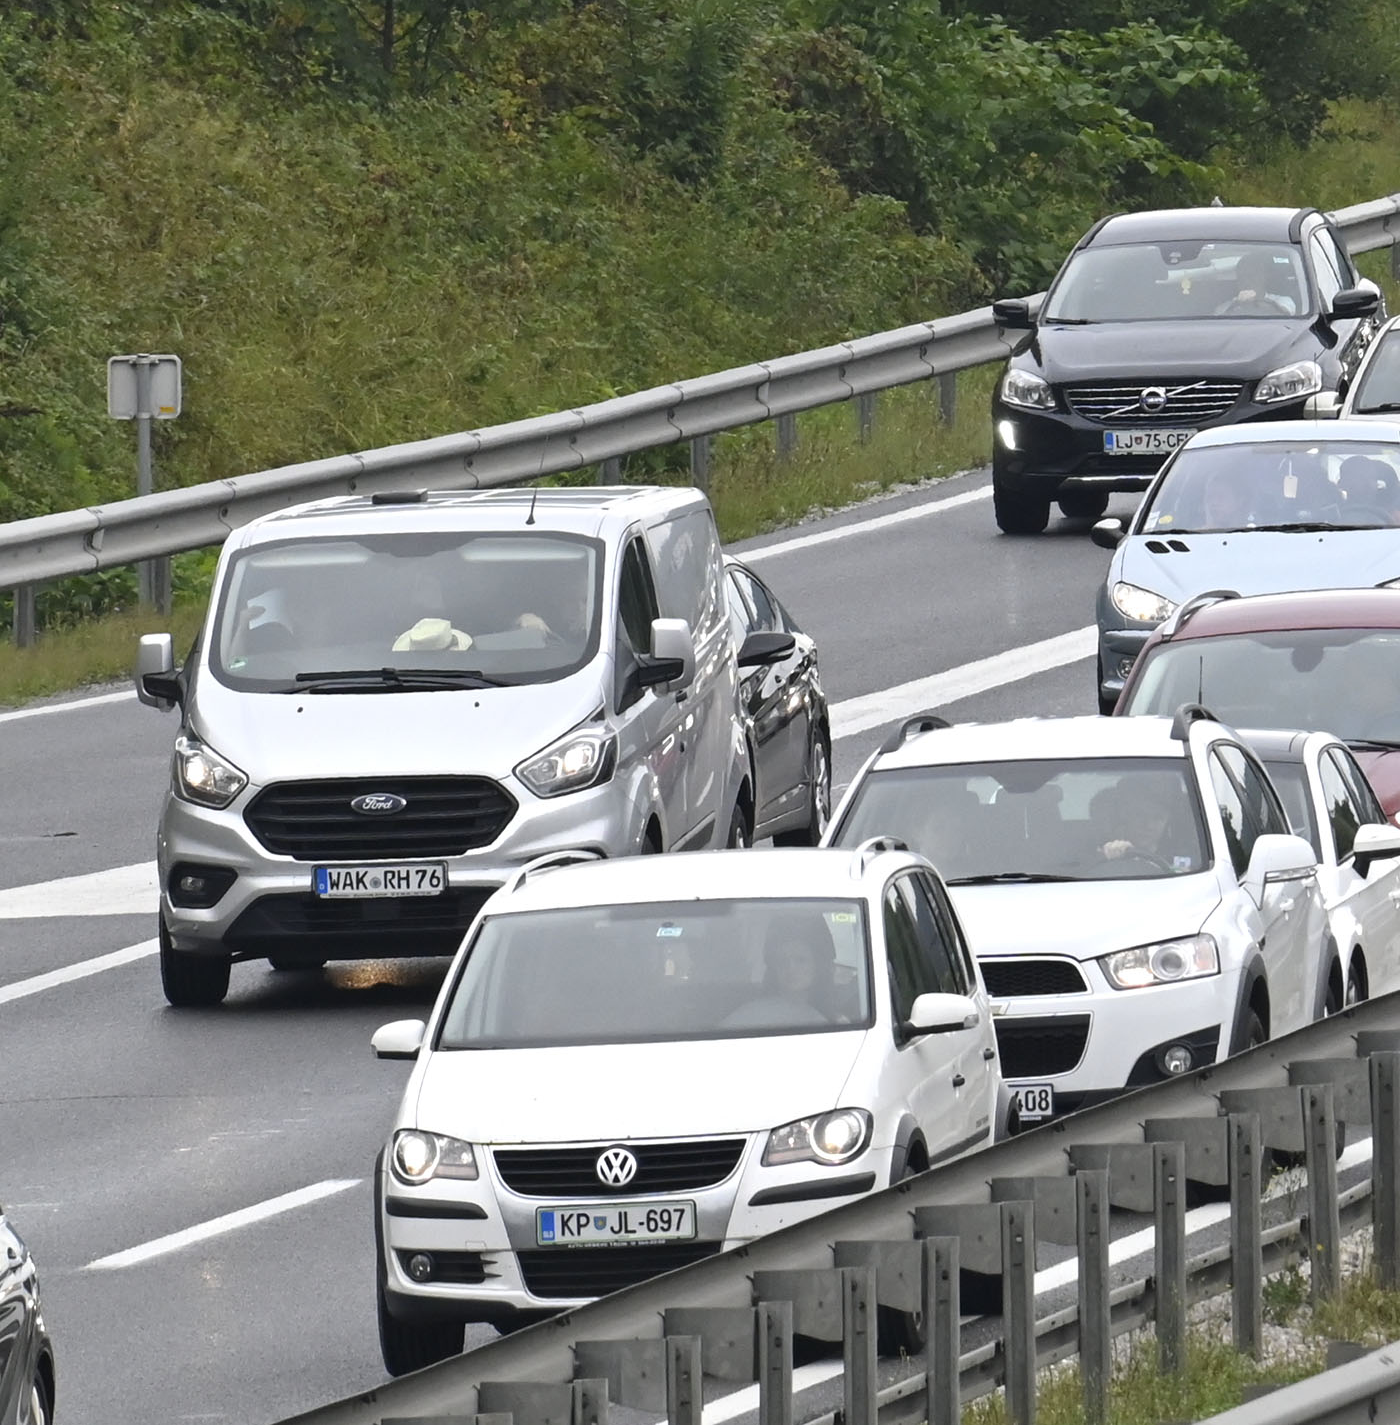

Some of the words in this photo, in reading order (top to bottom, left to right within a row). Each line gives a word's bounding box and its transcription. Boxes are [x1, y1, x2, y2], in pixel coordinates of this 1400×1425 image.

[1115, 434, 1133, 449] LJ
[362, 796, 394, 810] Ford
[328, 870, 368, 891] WAK
[384, 869, 410, 889] RH
[415, 869, 441, 889] 76
[561, 1212, 590, 1237] KP
[610, 1208, 686, 1235] JL-697
